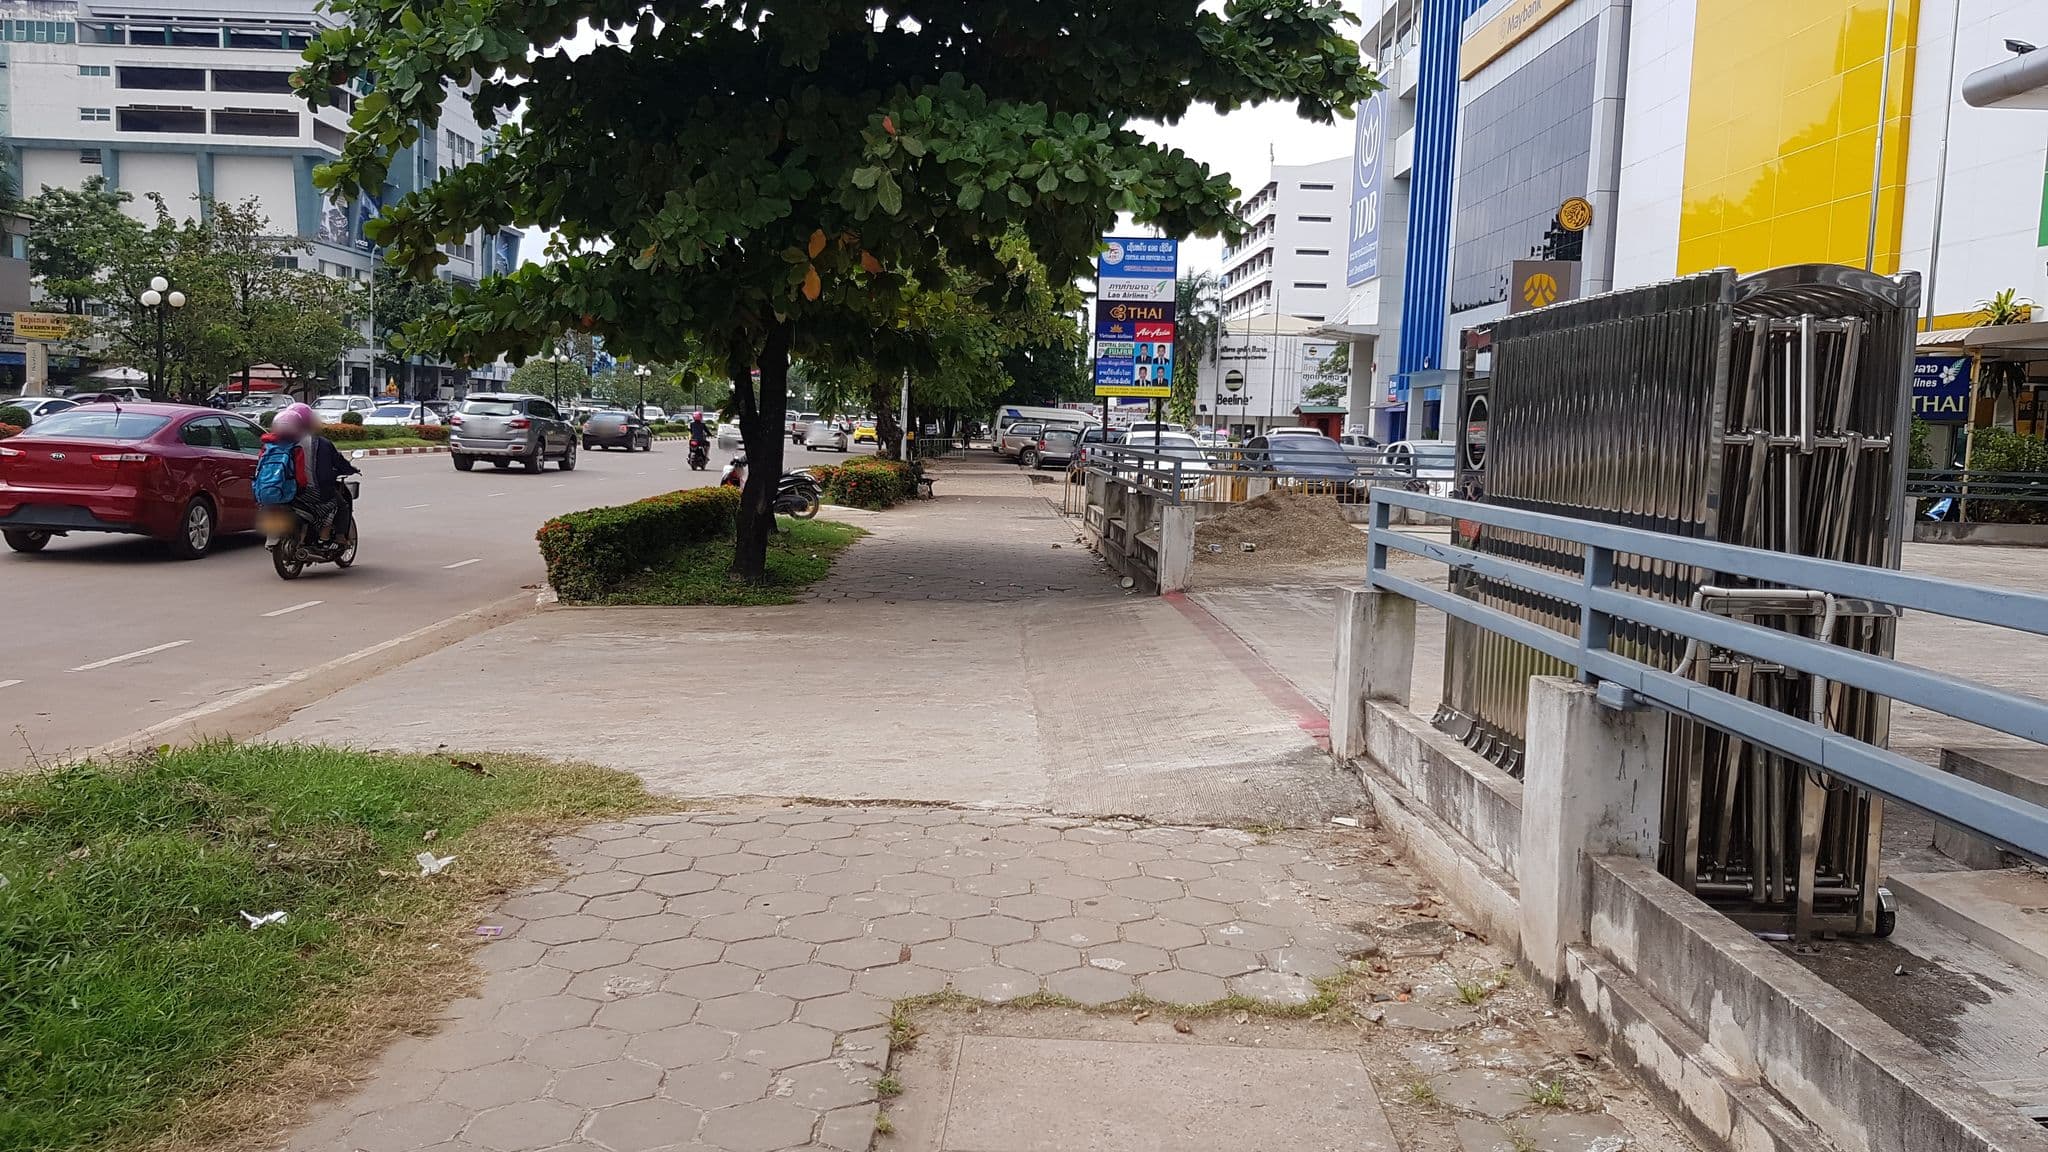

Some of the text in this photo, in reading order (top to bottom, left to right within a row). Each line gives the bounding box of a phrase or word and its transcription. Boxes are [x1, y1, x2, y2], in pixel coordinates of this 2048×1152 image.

[1507, 0, 1542, 34] Maybank
[1353, 190, 1377, 242] JDB
[1128, 307, 1163, 320] THAI
[1216, 394, 1249, 406] Beeline
[1911, 395, 1964, 412] THAI
